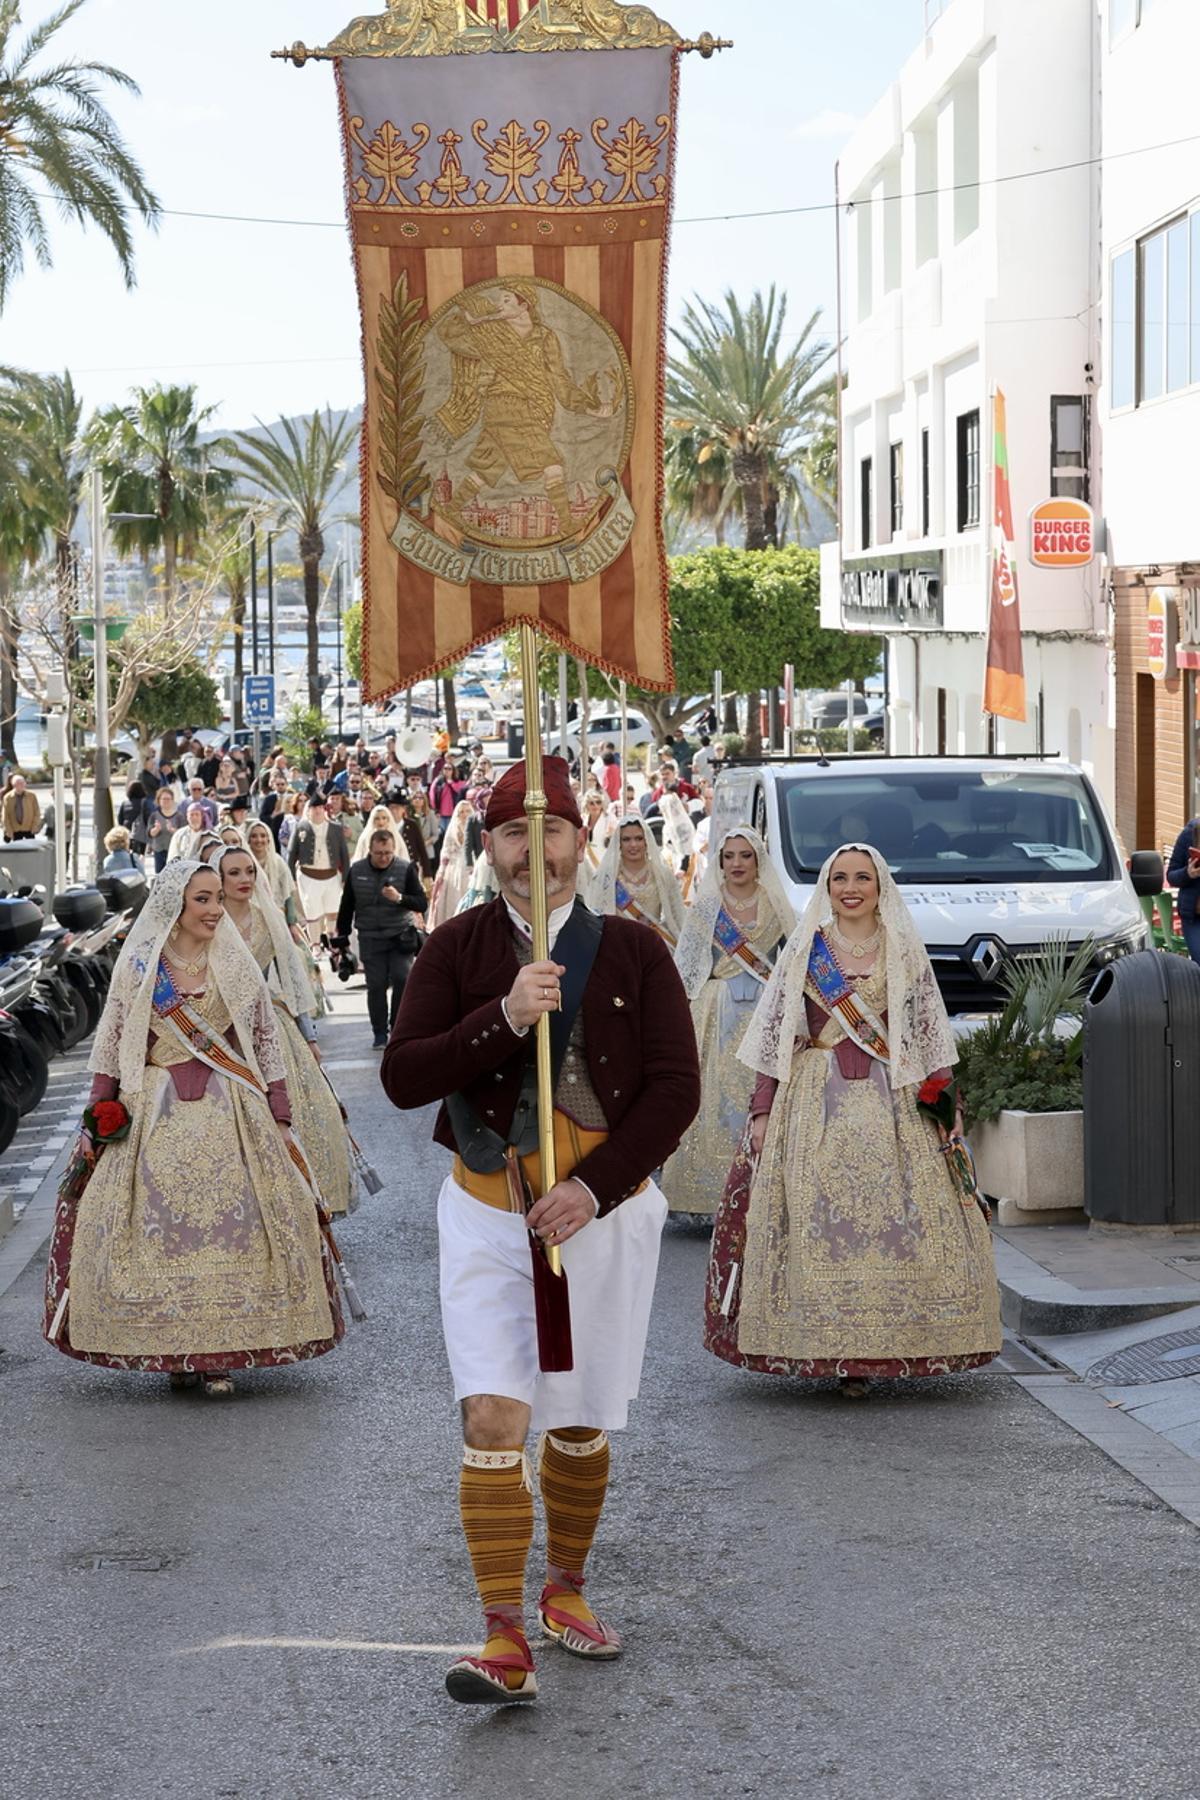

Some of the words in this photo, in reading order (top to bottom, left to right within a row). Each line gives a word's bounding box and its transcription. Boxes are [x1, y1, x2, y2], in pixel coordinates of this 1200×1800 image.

[1034, 521, 1090, 534] BURGER
[400, 522, 464, 581] Junta
[480, 549, 561, 581] Central
[569, 512, 633, 579] Fallera
[1034, 534, 1091, 553] KING
